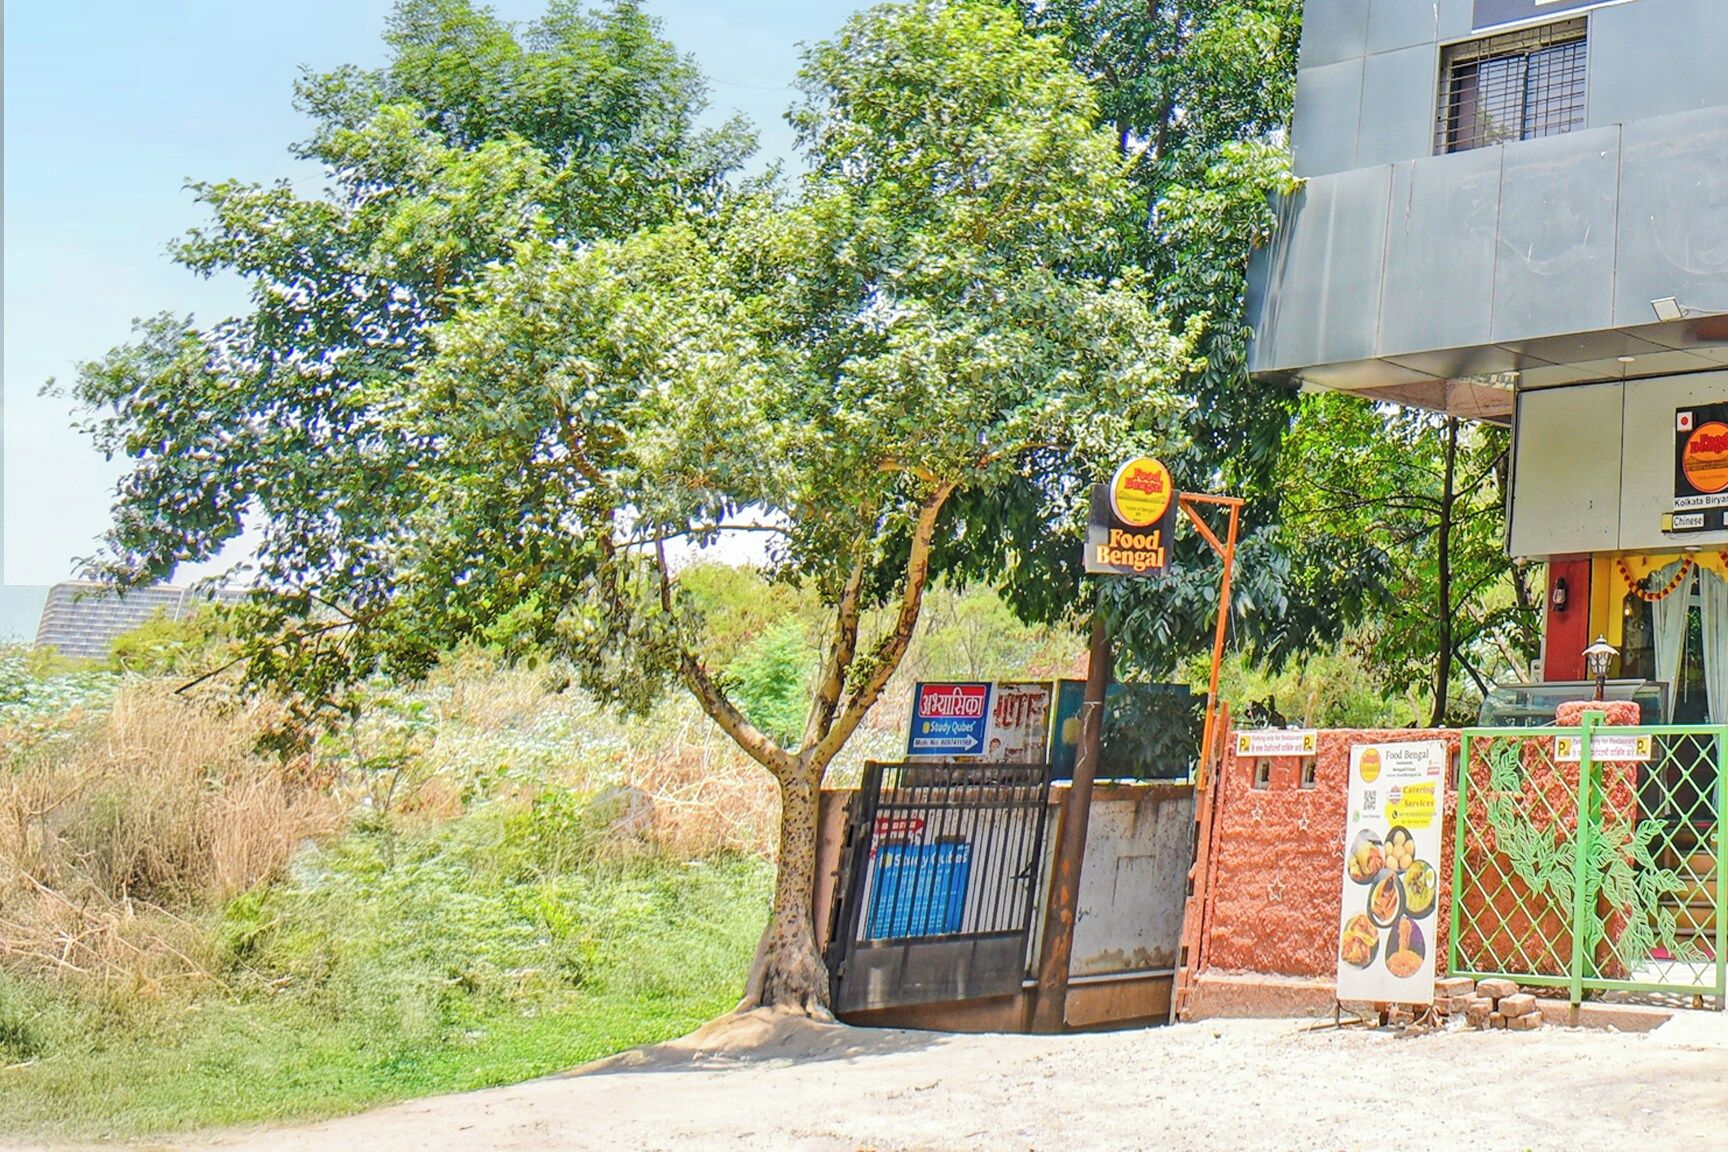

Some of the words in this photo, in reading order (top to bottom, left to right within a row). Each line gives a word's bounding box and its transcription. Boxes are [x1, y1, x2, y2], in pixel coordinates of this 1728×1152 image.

[1674, 497, 1704, 507] Kolkata
[1674, 516, 1703, 527] Chinese
[1109, 528, 1160, 550] Food
[1096, 543, 1165, 571] Bengal
[921, 686, 985, 716] अभ्यासिका
[930, 720, 950, 735] Study
[1386, 749, 1402, 760] Food
[1404, 748, 1429, 762] Bengal
[1403, 786, 1435, 795] Catering
[1404, 799, 1434, 808] Services
